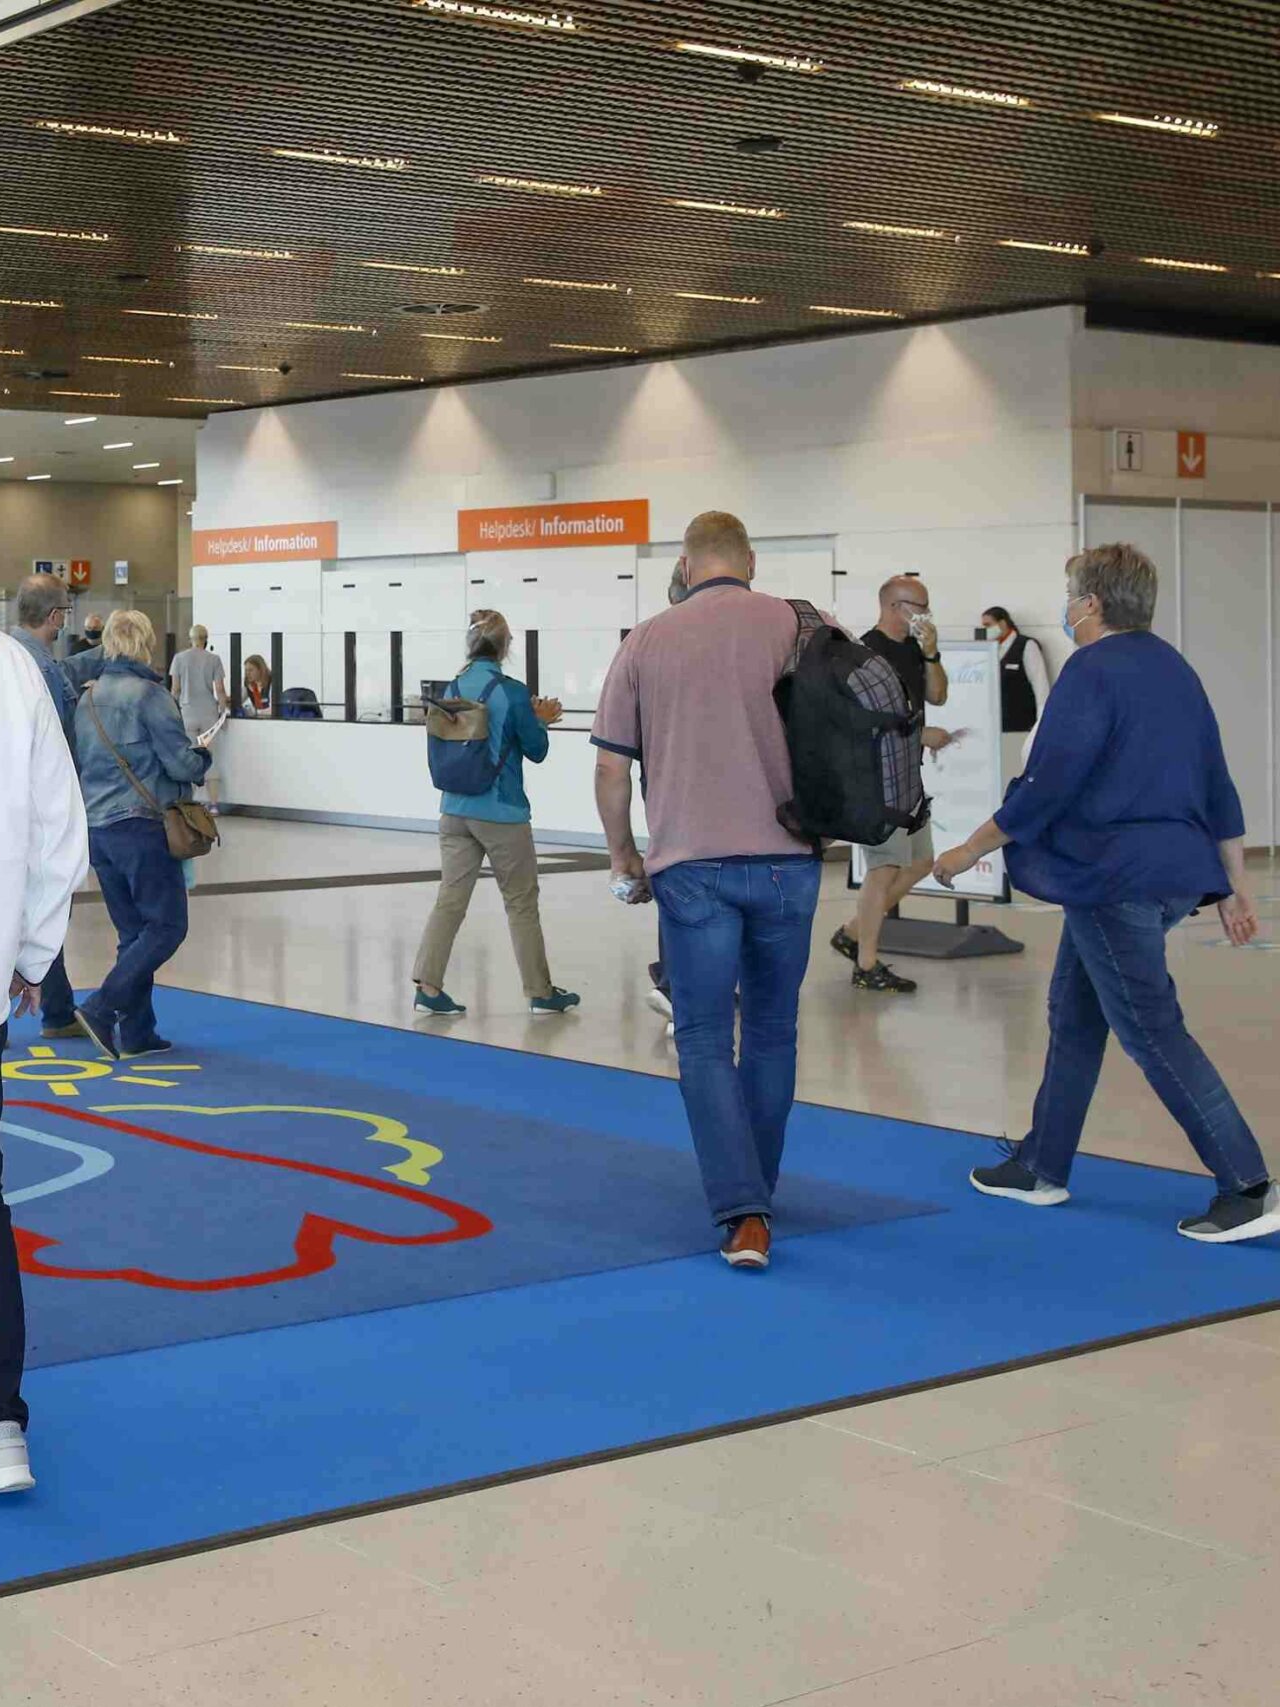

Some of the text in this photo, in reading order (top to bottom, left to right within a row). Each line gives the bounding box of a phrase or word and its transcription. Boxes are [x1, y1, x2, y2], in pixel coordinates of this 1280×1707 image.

[480, 513, 625, 543] Helpdesk/ Information
[207, 533, 318, 560] Helpdesk/ Information
